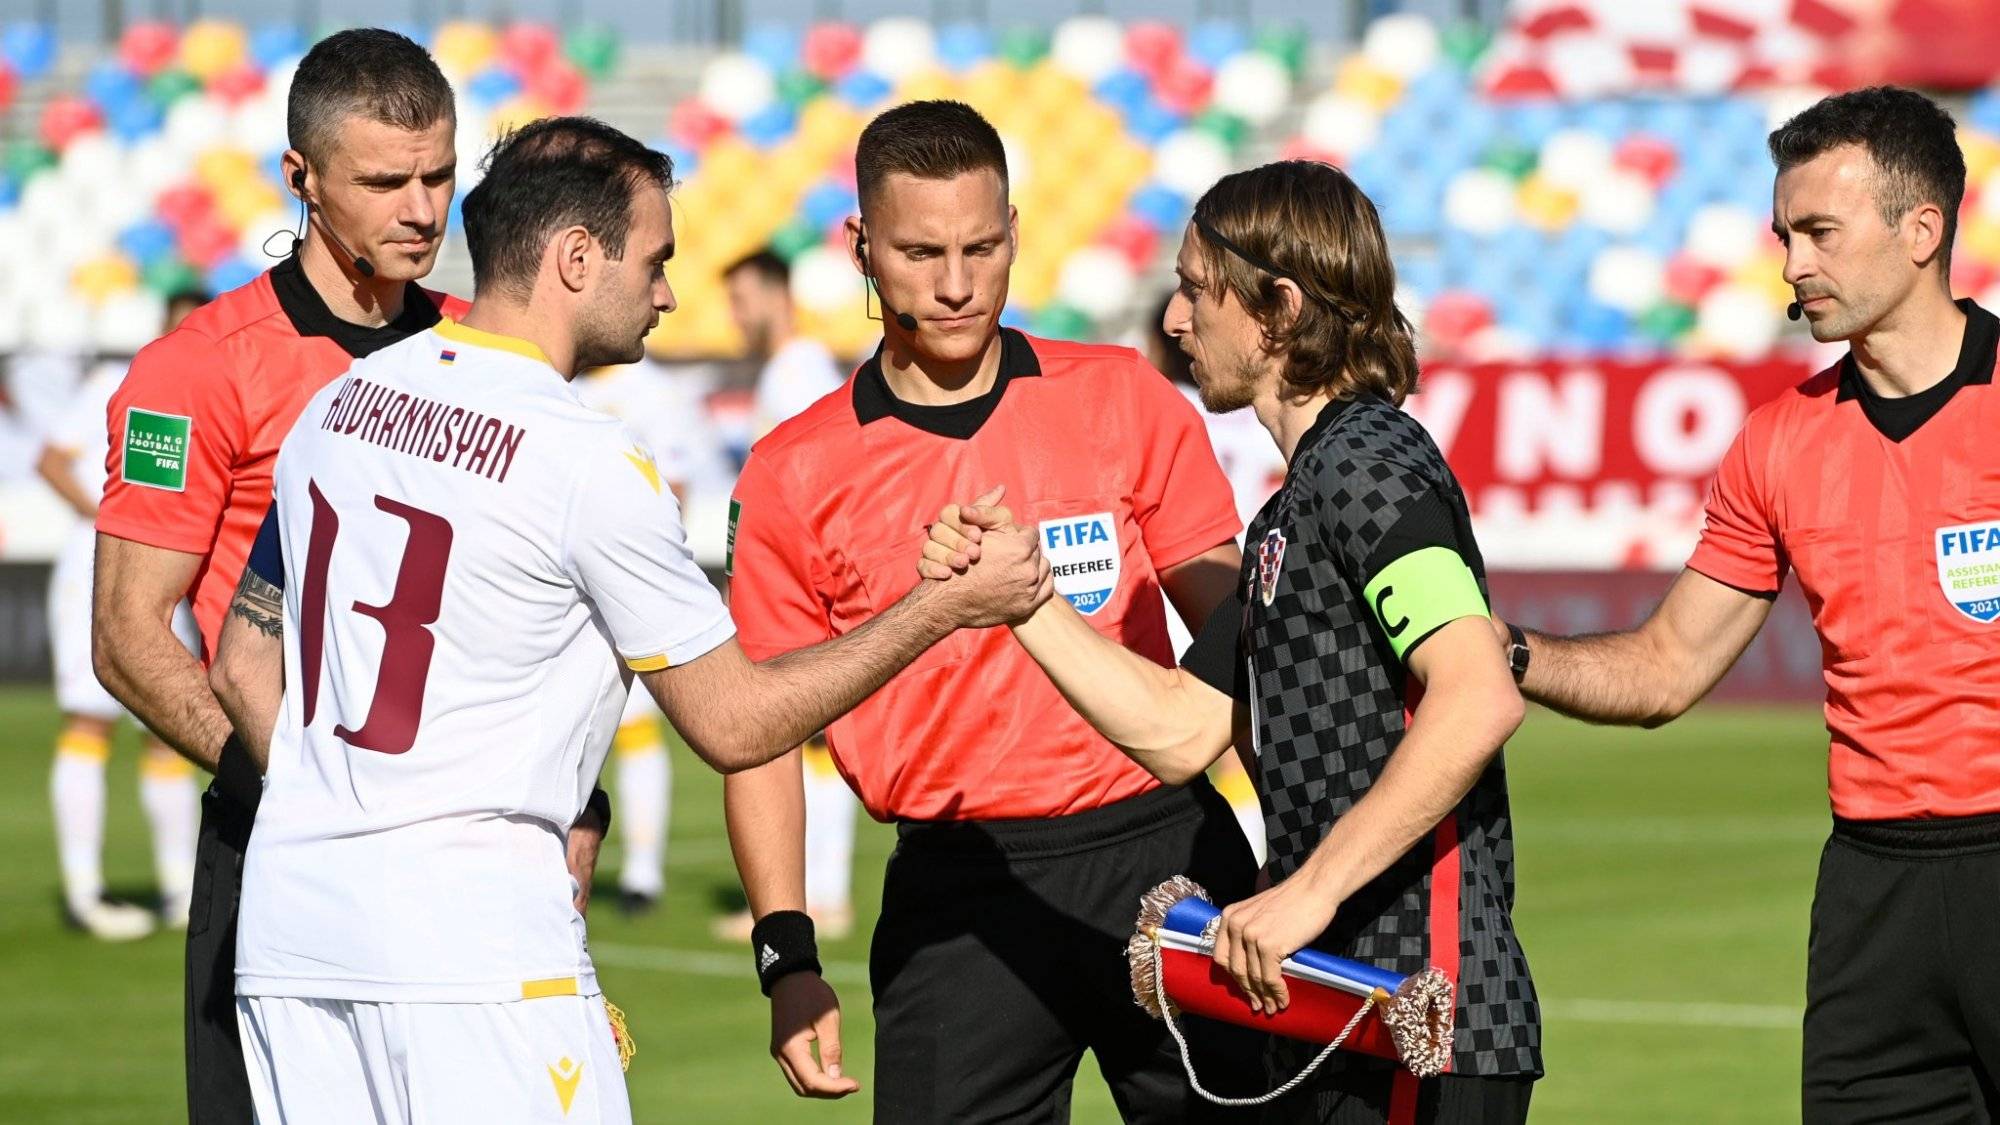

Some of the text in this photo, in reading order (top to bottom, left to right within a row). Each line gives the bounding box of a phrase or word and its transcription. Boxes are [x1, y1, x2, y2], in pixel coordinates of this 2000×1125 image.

[130, 429, 182, 445] LIVING
[321, 378, 526, 483] HOVHANNISYAN
[129, 437, 182, 453] FOOTBALL
[155, 458, 180, 470] FIFA
[1045, 520, 1109, 549] FIFA
[1941, 527, 2000, 556] FIFA
[1052, 558, 1114, 577] REFEREE
[1952, 574, 2000, 590] REFERE
[1073, 592, 1102, 606] 2021
[1969, 599, 2000, 614] 2021
[300, 476, 454, 755] 13
[1375, 585, 1410, 638] C
